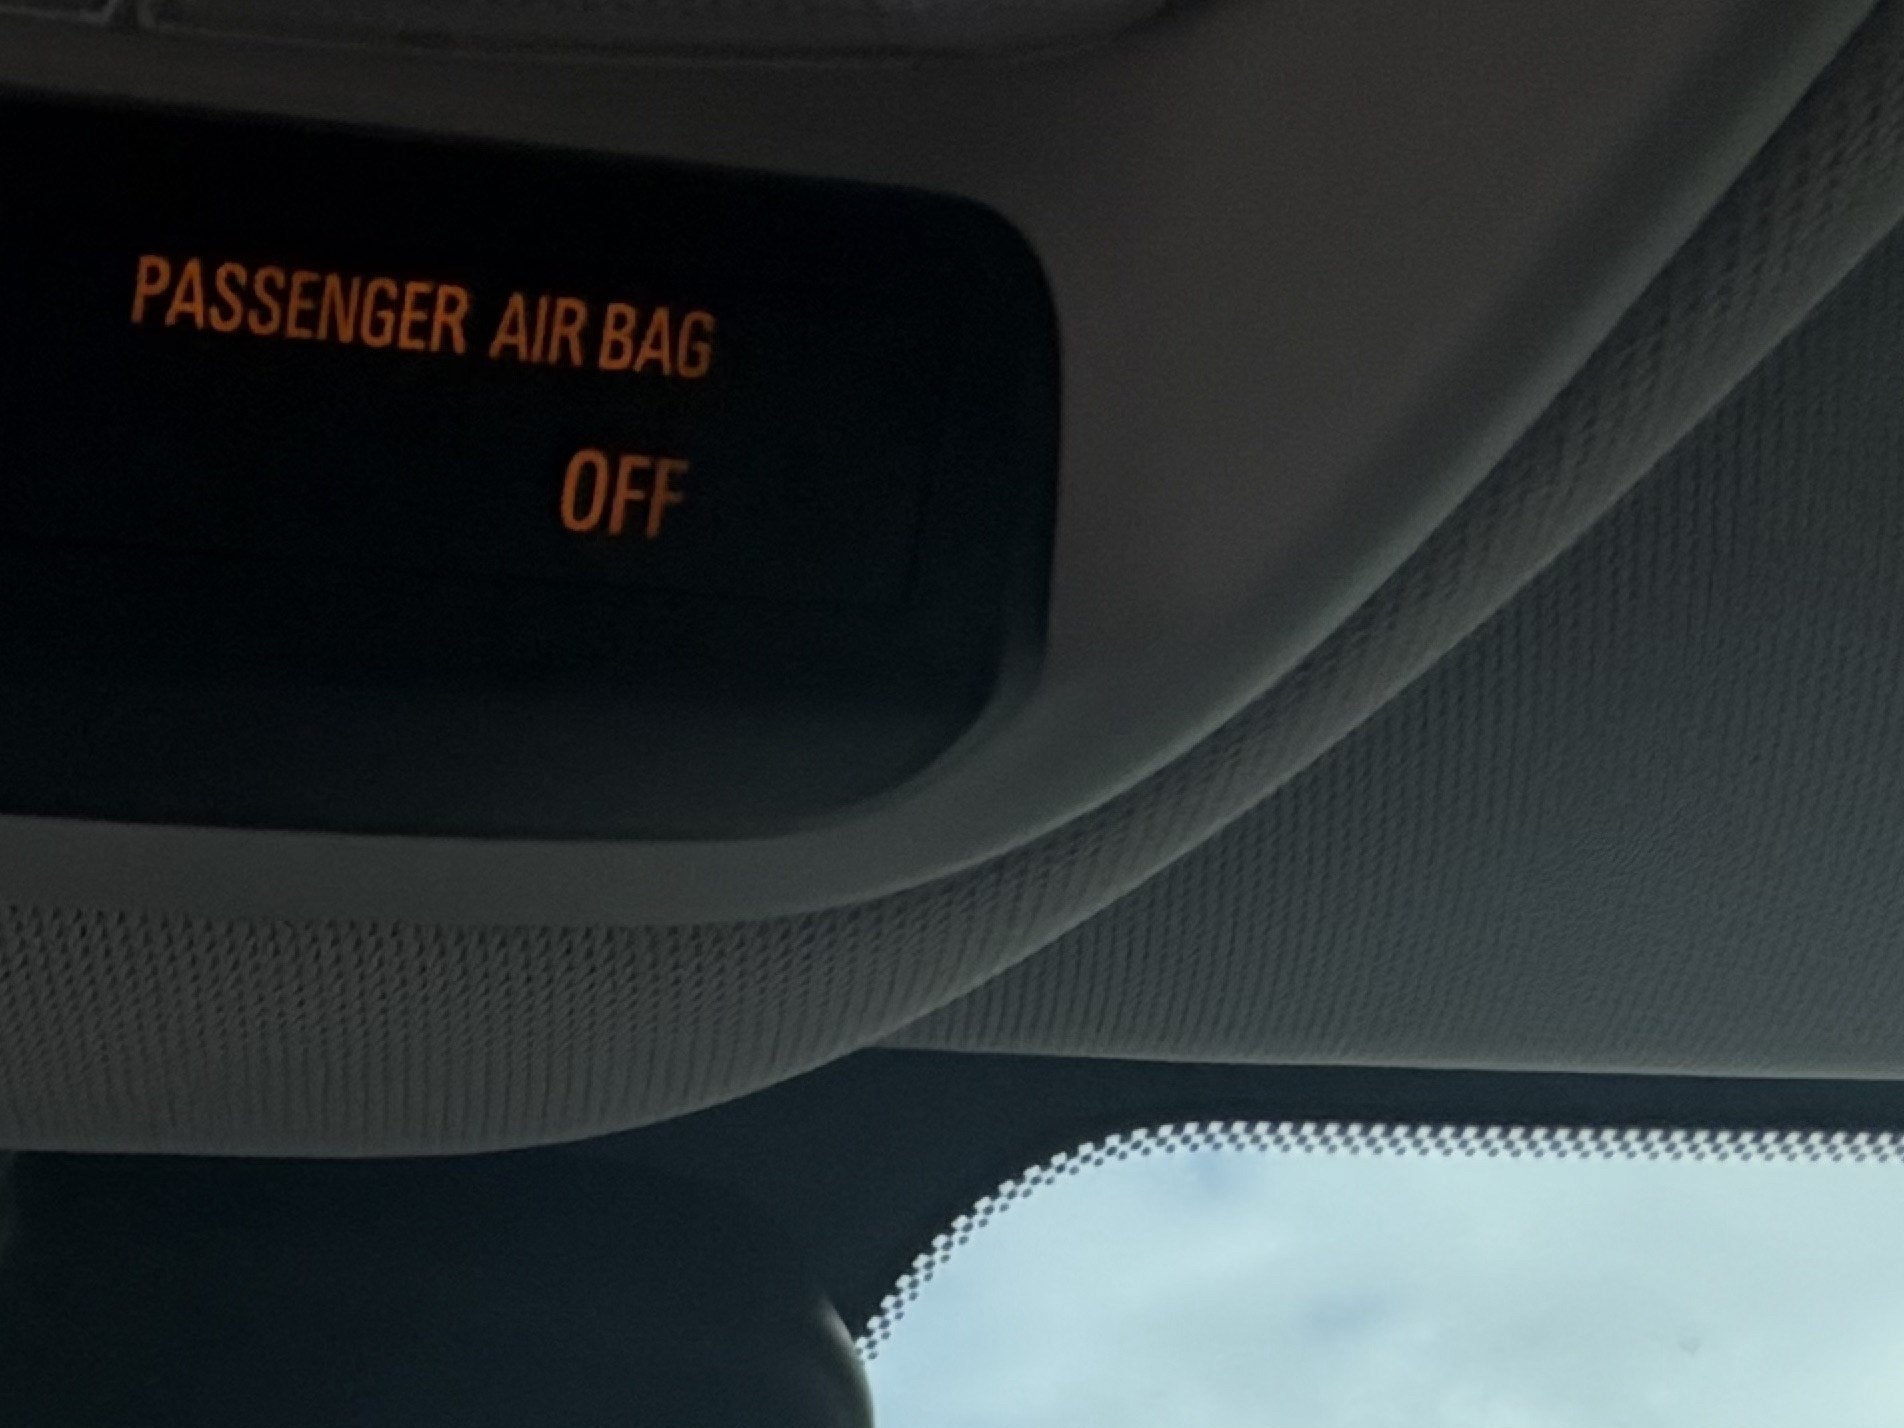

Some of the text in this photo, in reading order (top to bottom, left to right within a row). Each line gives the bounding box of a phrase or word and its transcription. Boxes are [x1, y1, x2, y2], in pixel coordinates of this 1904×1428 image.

[130, 254, 716, 379] PASSENGER AIR BAG
[560, 447, 690, 538] OFF
